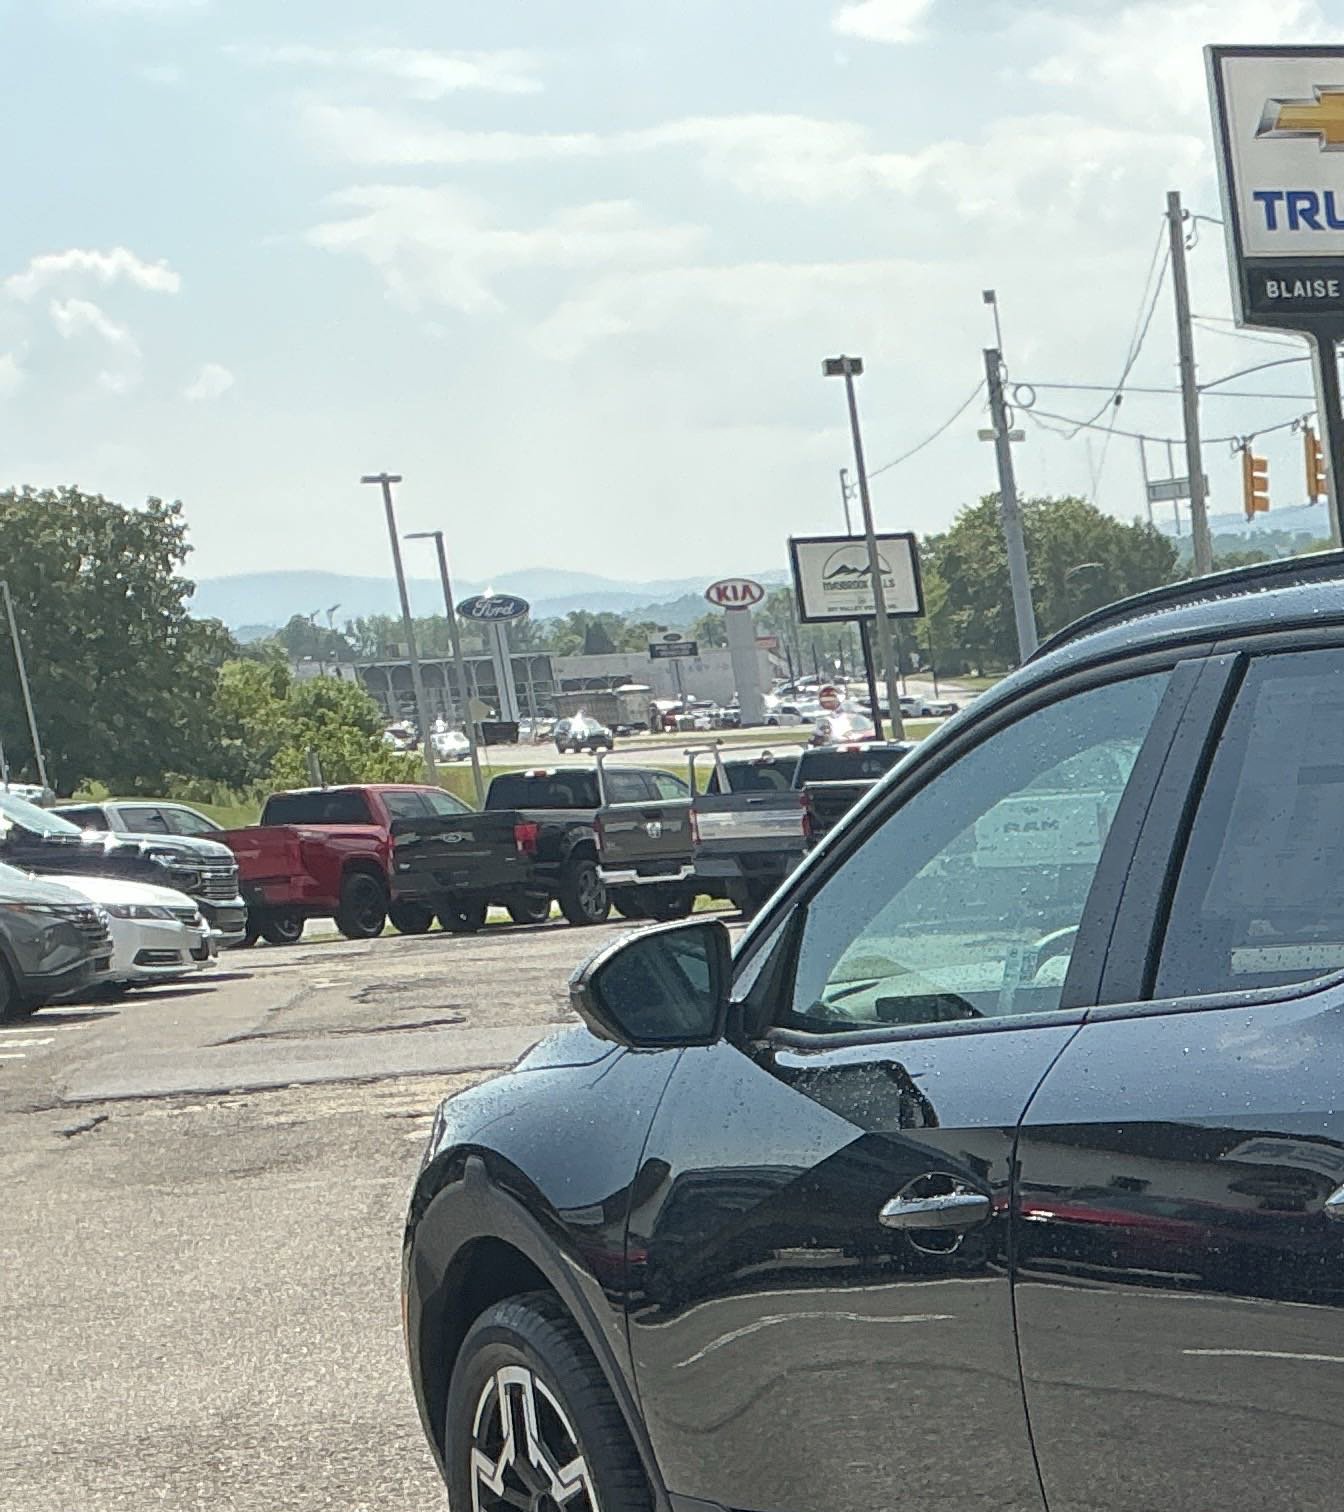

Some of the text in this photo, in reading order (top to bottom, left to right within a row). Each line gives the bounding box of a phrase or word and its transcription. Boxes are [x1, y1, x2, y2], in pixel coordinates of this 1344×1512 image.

[1266, 279, 1340, 298] BLAISE
[716, 584, 756, 601] KIA
[472, 599, 514, 617] Ford
[1003, 819, 1060, 833] RAM
